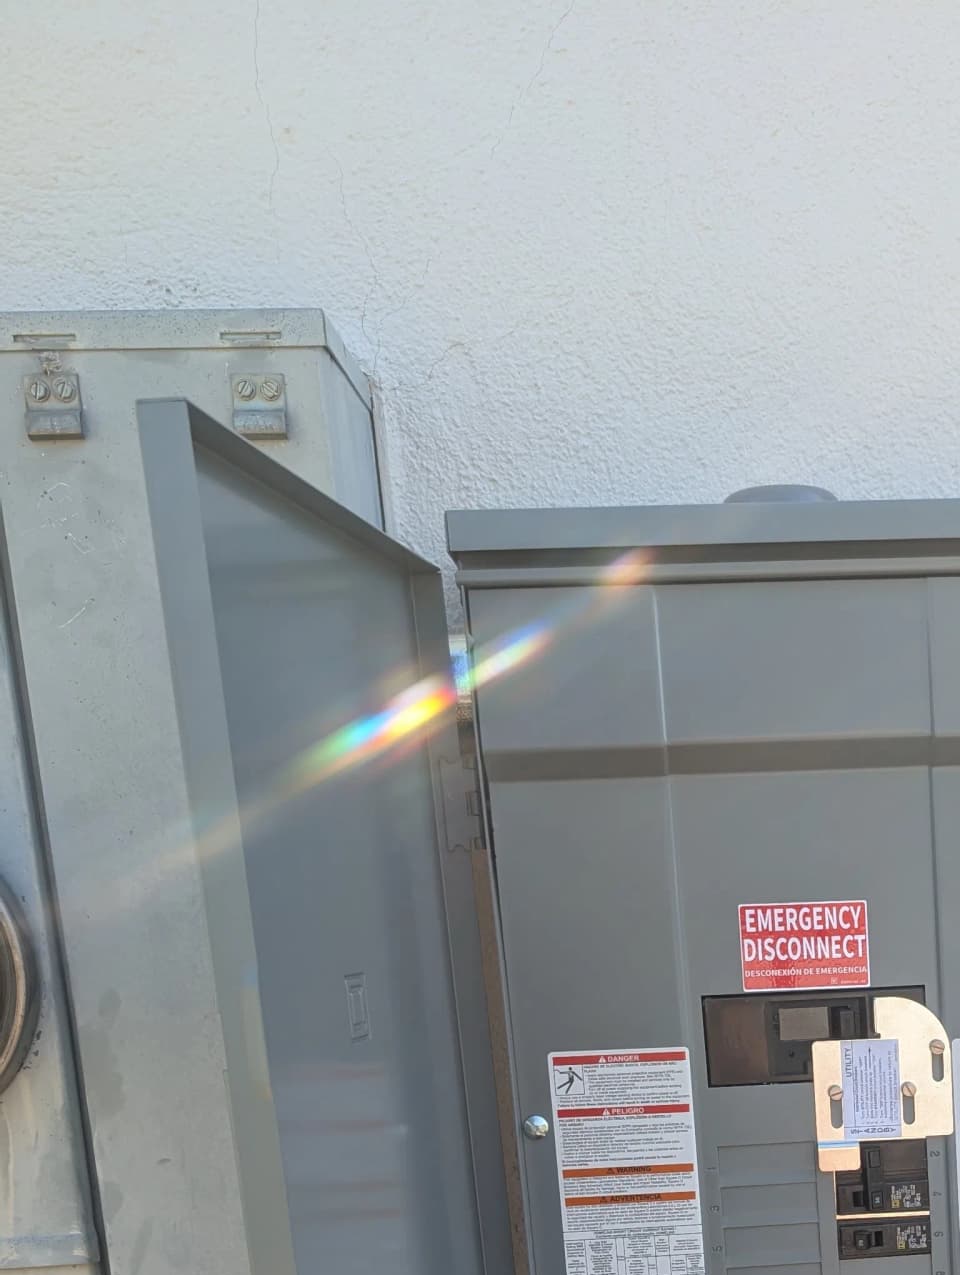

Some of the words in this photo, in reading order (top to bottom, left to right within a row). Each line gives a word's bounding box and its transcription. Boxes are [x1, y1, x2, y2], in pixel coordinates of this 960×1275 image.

[745, 905, 862, 933] EMERGENCY
[743, 934, 866, 962] DISCONNECT
[745, 966, 802, 978] DESCONEXIÓN
[803, 968, 815, 976] DE
[815, 966, 868, 976] EMERGENCIA
[607, 1055, 640, 1063] DANGER
[845, 1047, 853, 1078] UTILITY
[611, 1107, 645, 1115] PELIGRO
[850, 1127, 897, 1135] STANDBY
[616, 1166, 652, 1174] WARNING
[610, 1193, 662, 1202] ADVERTENCIA
